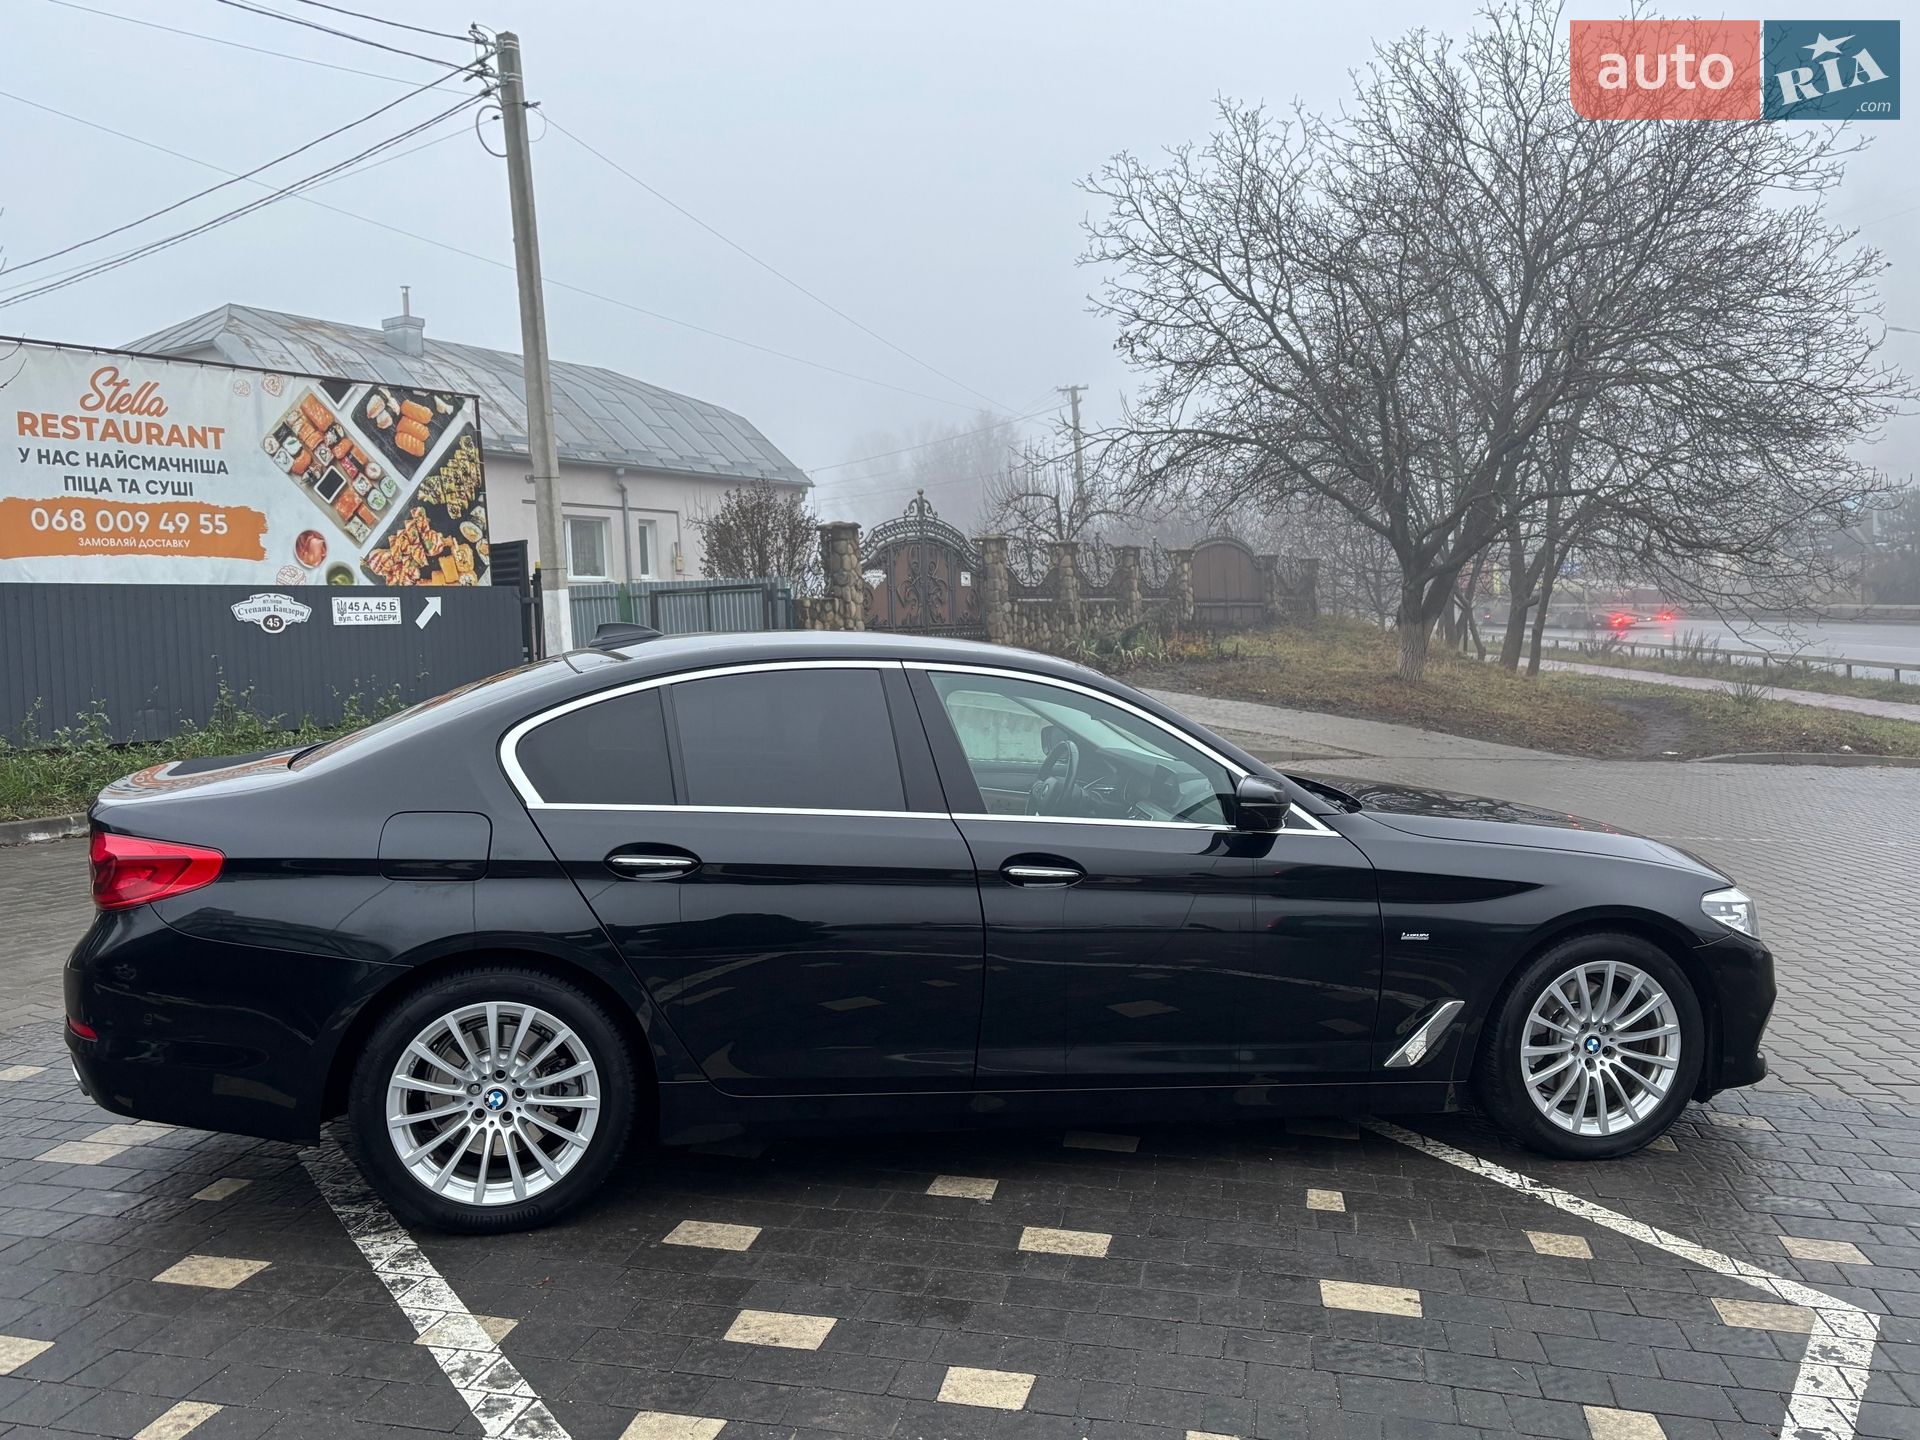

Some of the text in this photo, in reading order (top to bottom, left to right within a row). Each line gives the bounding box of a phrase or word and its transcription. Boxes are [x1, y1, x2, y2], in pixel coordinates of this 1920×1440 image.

[79, 366, 169, 418] Stella
[16, 411, 226, 450] RESTAURANT
[17, 447, 229, 475] У НАС НАЙСМАЧНІША
[63, 475, 194, 497] ПІЦА ТА СУШІ
[30, 507, 229, 535] 068 009 49 55
[78, 536, 191, 549] ЗАМОВЛЯЙ ДОСТАВКУ
[237, 604, 306, 618] Степана Бандери
[348, 601, 360, 612] 45
[375, 601, 388, 612] 45
[389, 601, 397, 611] Б
[266, 617, 281, 628] 45
[338, 614, 398, 623] вул. С. БАНДЕРИ
